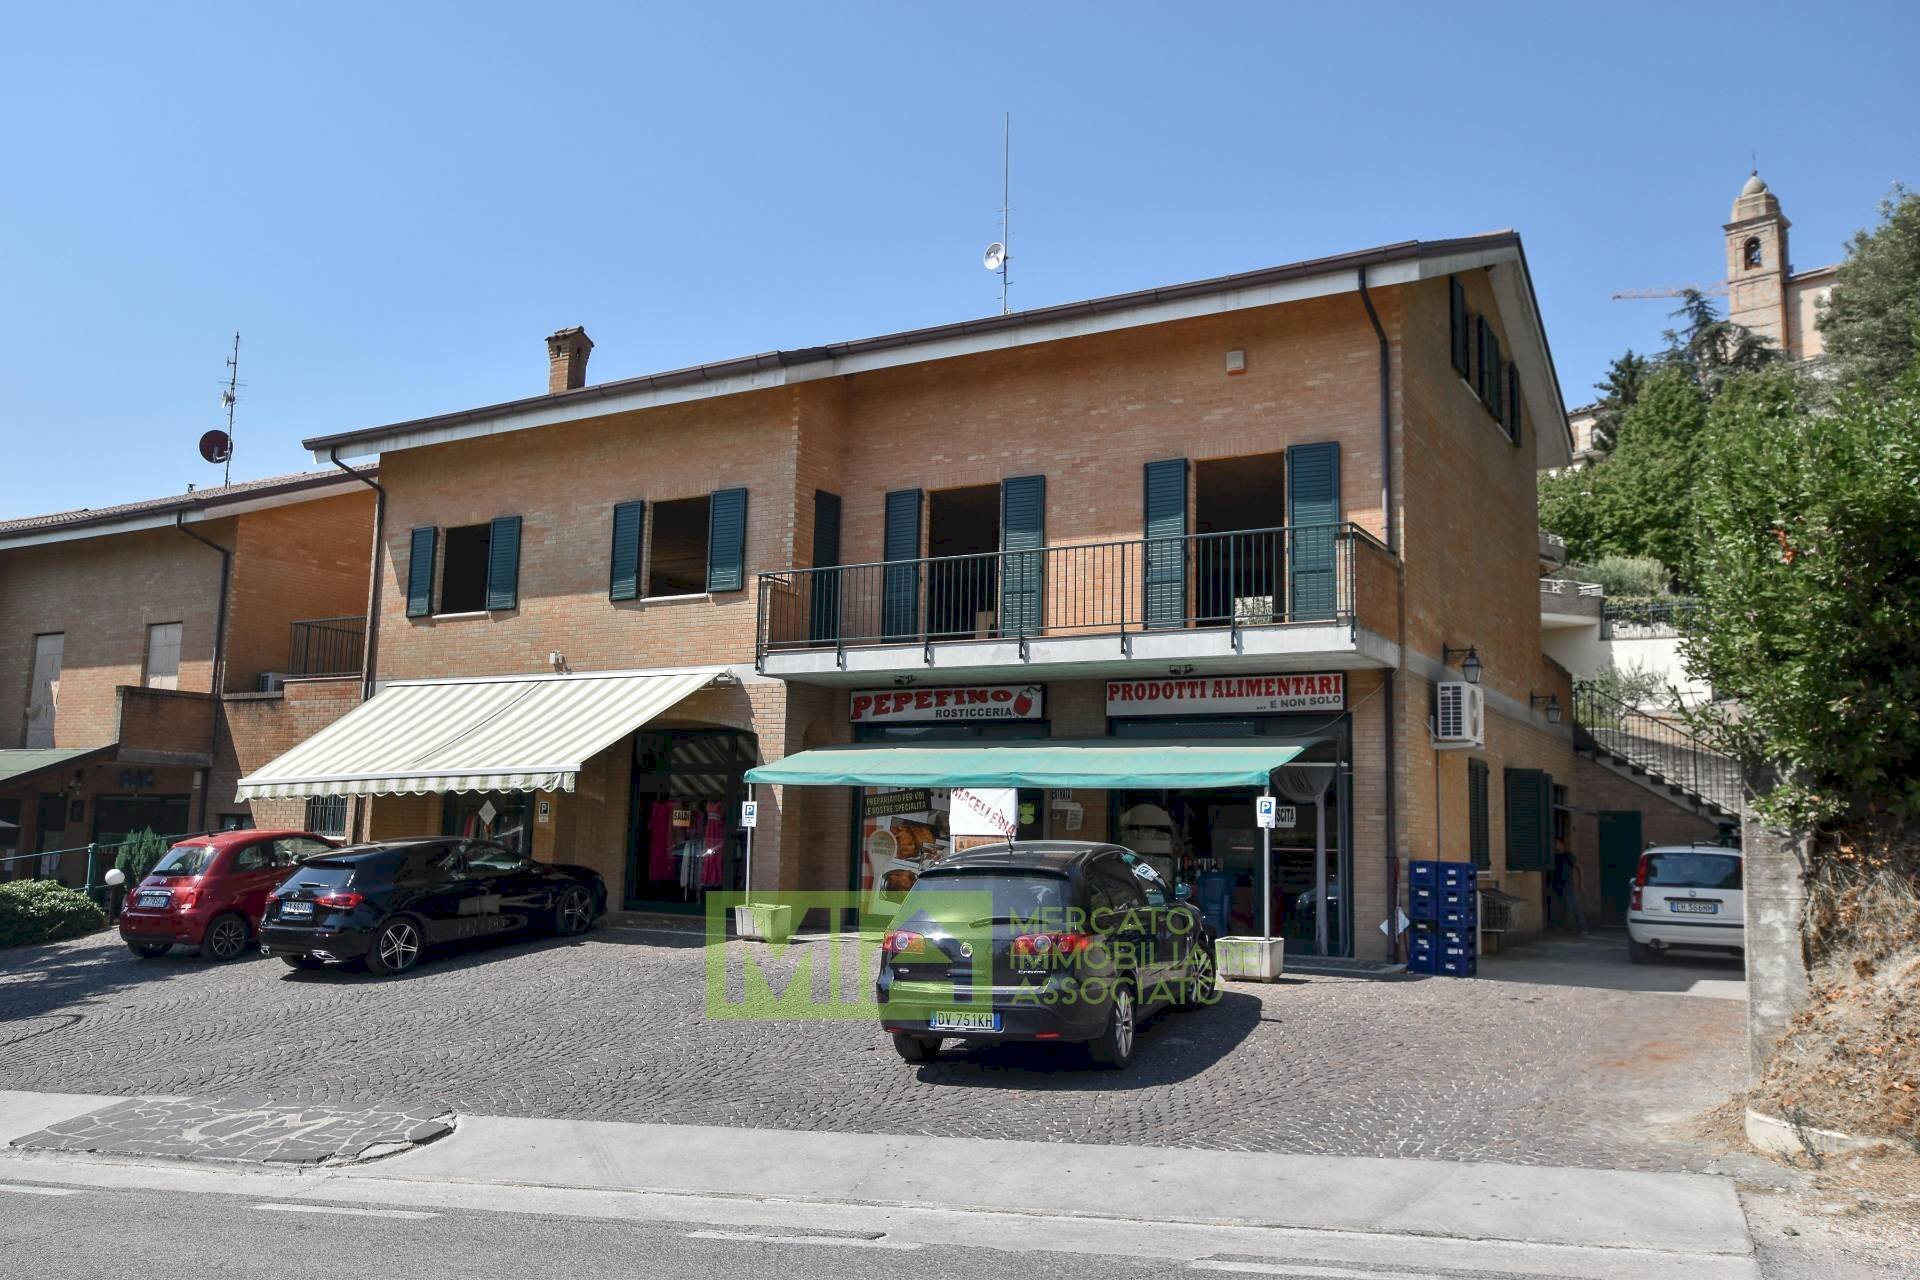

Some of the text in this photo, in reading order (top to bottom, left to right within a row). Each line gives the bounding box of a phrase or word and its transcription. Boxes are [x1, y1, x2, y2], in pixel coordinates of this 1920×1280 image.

[1107, 675, 1342, 701] PRODOTTI ALIMENTARI
[851, 689, 1013, 720] PEPEFINO
[1270, 699, 1277, 709] E
[1280, 698, 1306, 709] NON
[1310, 695, 1342, 706] SOLO
[935, 707, 1013, 719] ROSTICCERIA
[902, 792, 914, 802] PER
[914, 791, 926, 800] VOI
[1276, 807, 1295, 823] SCITA
[938, 1012, 992, 1028] DV 751KH
